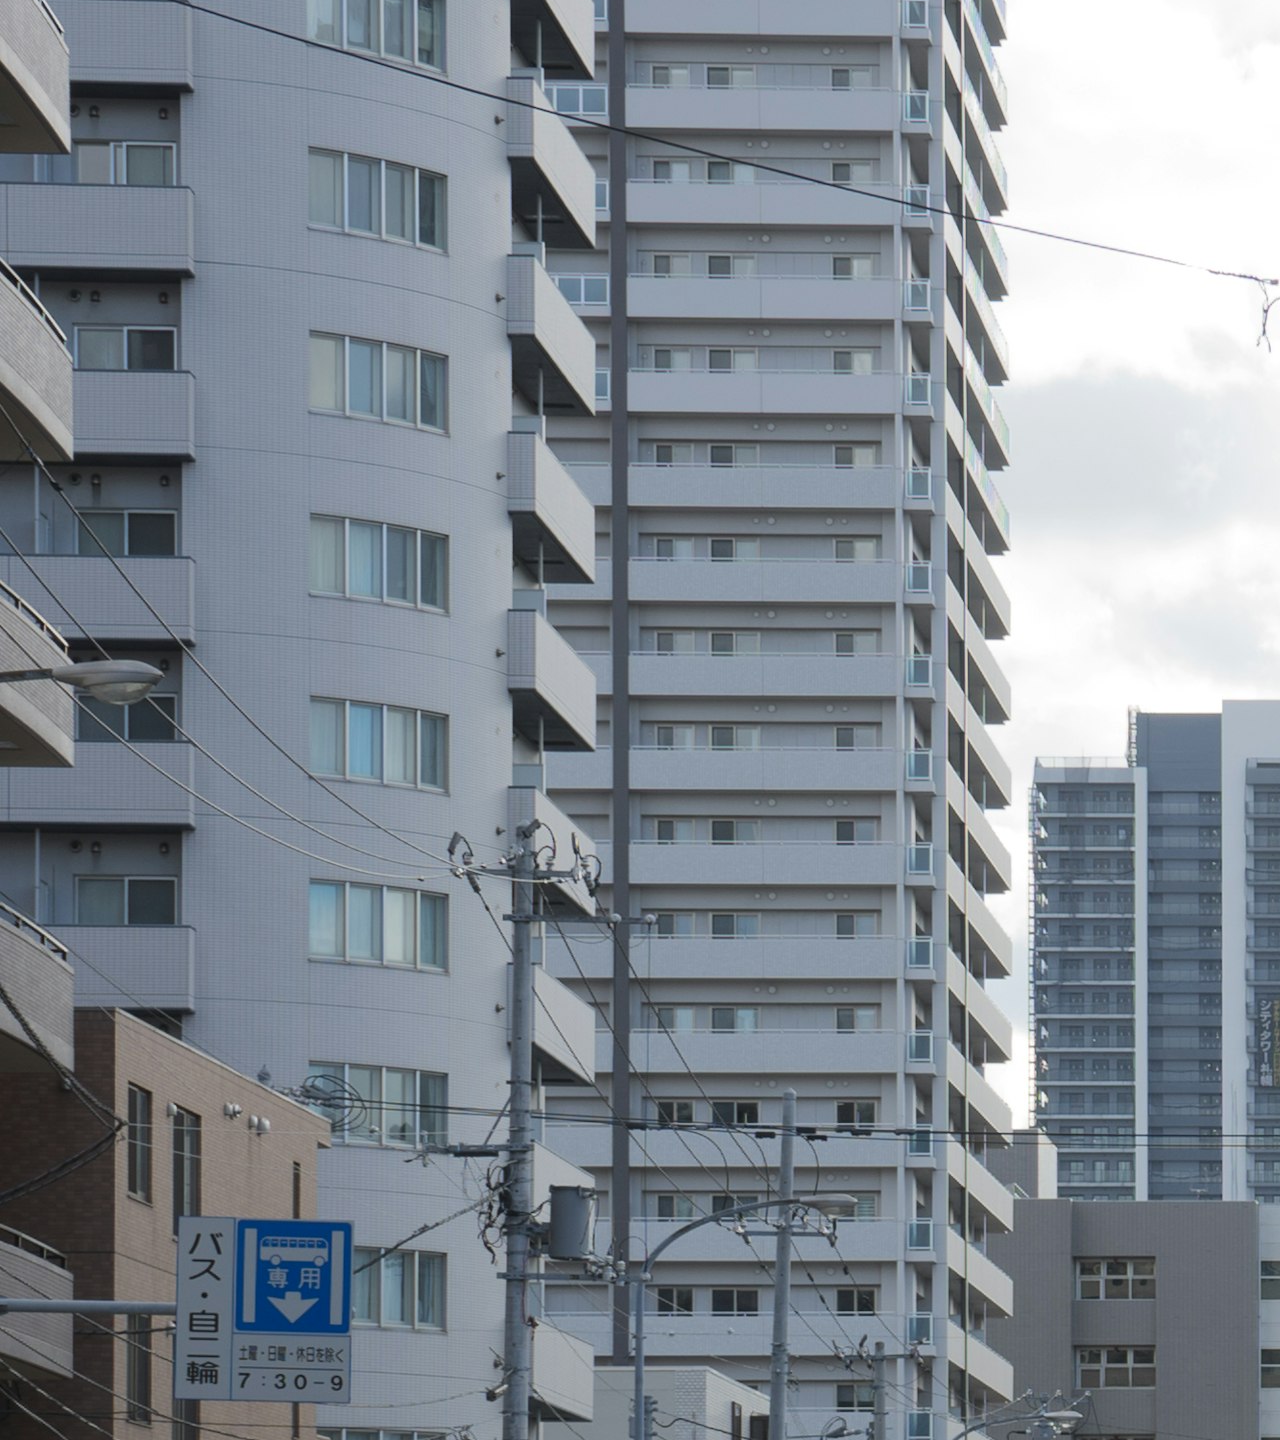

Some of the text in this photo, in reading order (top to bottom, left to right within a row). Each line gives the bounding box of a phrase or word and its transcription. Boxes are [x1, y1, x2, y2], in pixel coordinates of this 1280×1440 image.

[185, 1232, 223, 1385] バス・自二輪
[267, 1267, 321, 1290] 専用
